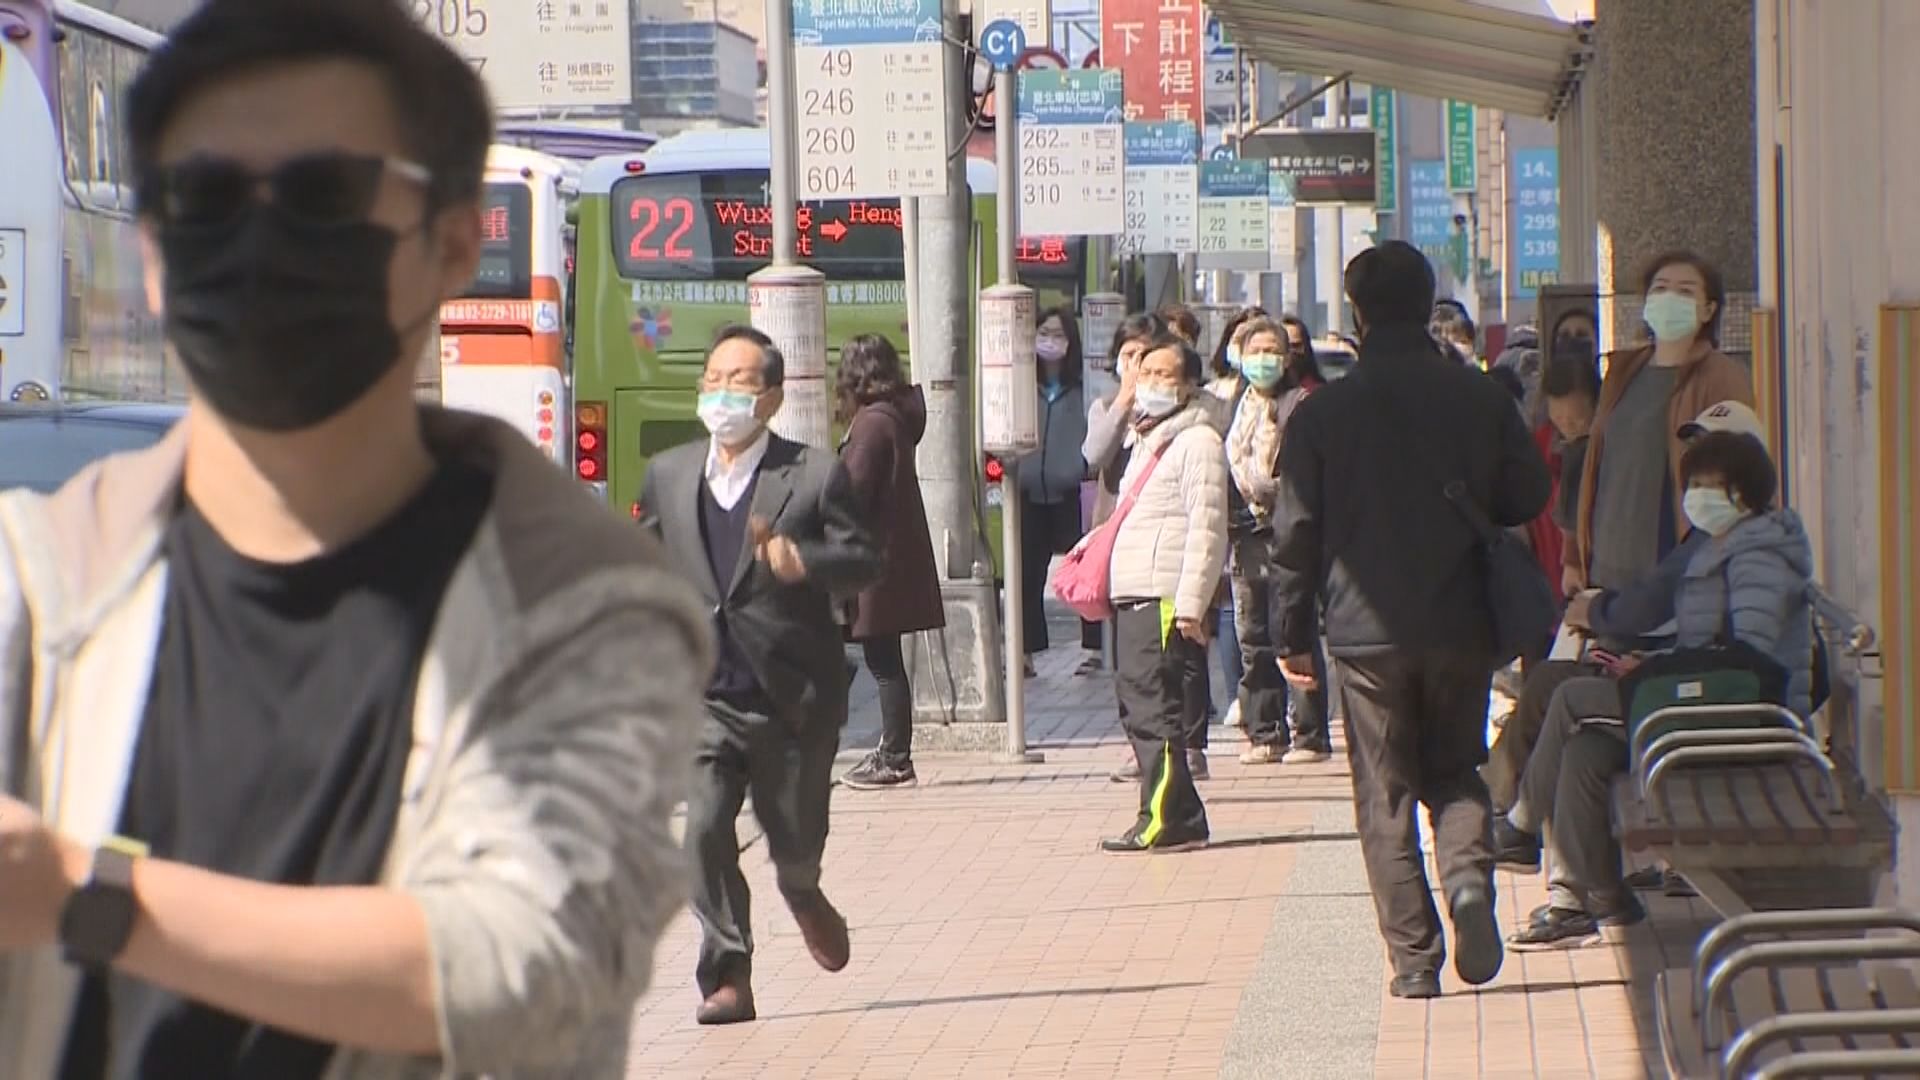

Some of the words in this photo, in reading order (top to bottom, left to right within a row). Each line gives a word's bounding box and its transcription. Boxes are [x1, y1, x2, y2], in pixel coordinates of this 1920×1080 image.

[537, 1, 556, 21] 往
[838, 17, 856, 27] Main
[987, 30, 1017, 55] C1
[1113, 23, 1144, 54] 下
[539, 62, 558, 81] 往
[567, 64, 614, 76] 板橋國中
[820, 50, 852, 77] 49
[805, 88, 853, 116] 246
[806, 127, 855, 154] 260
[1023, 127, 1059, 149] 262
[1024, 156, 1060, 176] 265
[808, 166, 856, 193] 604
[1025, 183, 1061, 205] 310
[1127, 190, 1145, 208] 21
[715, 201, 813, 231] Wuxg
[1127, 212, 1147, 230] 32
[1210, 217, 1227, 232] 22
[629, 199, 694, 259] 22
[734, 231, 813, 255] Strt
[1118, 234, 1146, 253] 247
[1202, 236, 1227, 250] 276
